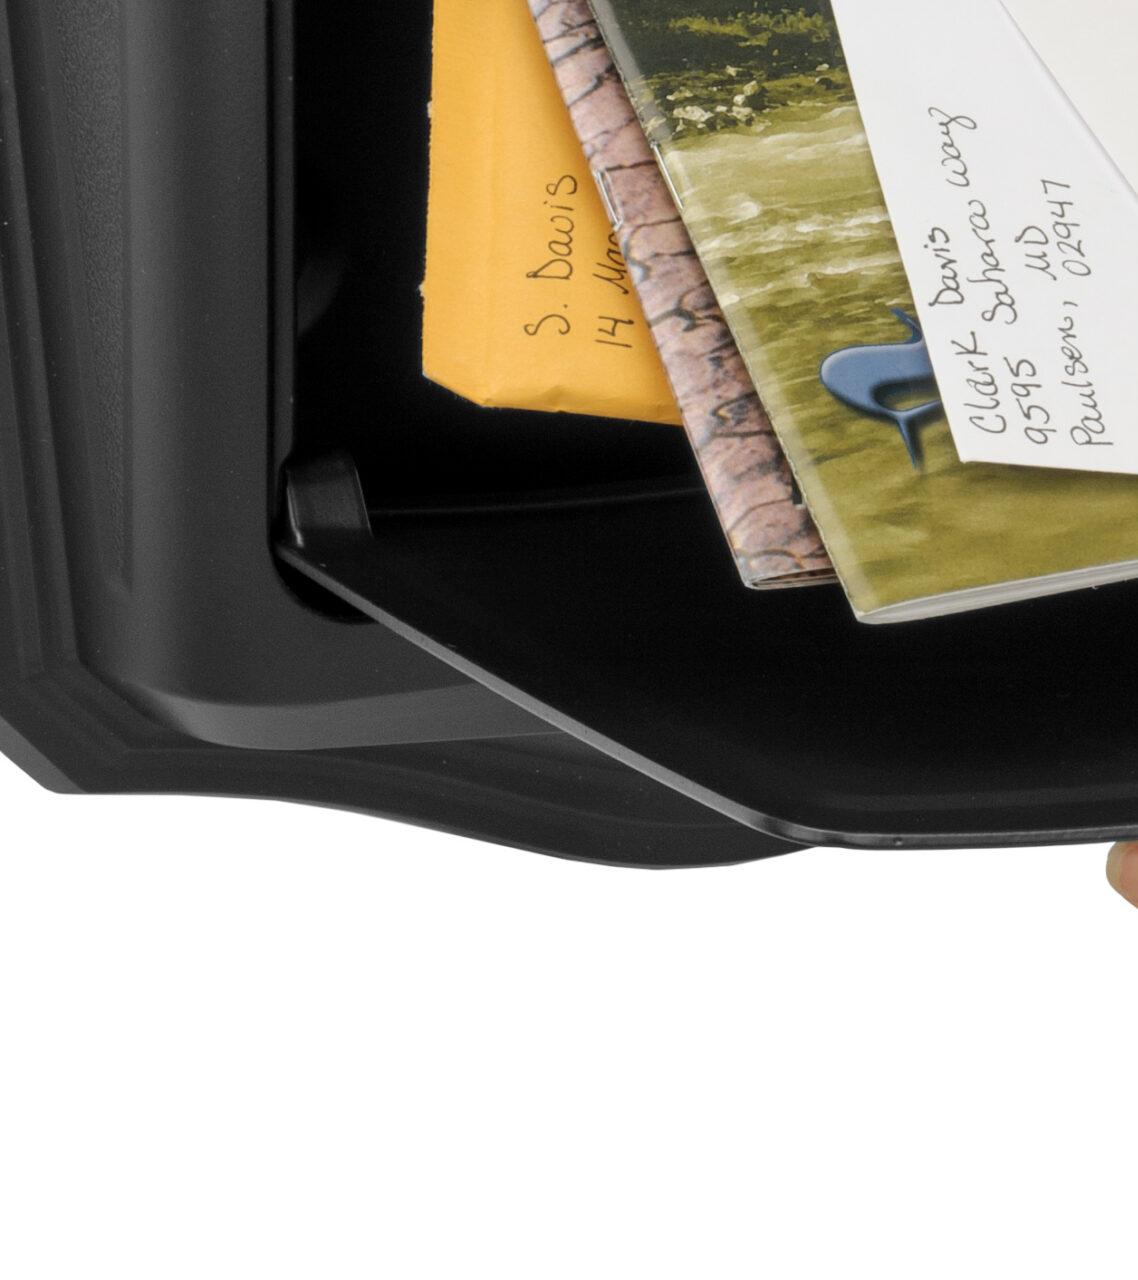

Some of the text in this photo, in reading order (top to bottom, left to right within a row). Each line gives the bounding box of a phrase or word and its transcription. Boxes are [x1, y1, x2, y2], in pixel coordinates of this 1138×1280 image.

[525, 174, 578, 280] Davis
[967, 199, 1018, 325] Sahara
[1040, 179, 1092, 277] 02947
[595, 315, 635, 348] 14
[923, 226, 1008, 434] Clark Davis
[1003, 356, 1057, 445] 9595
